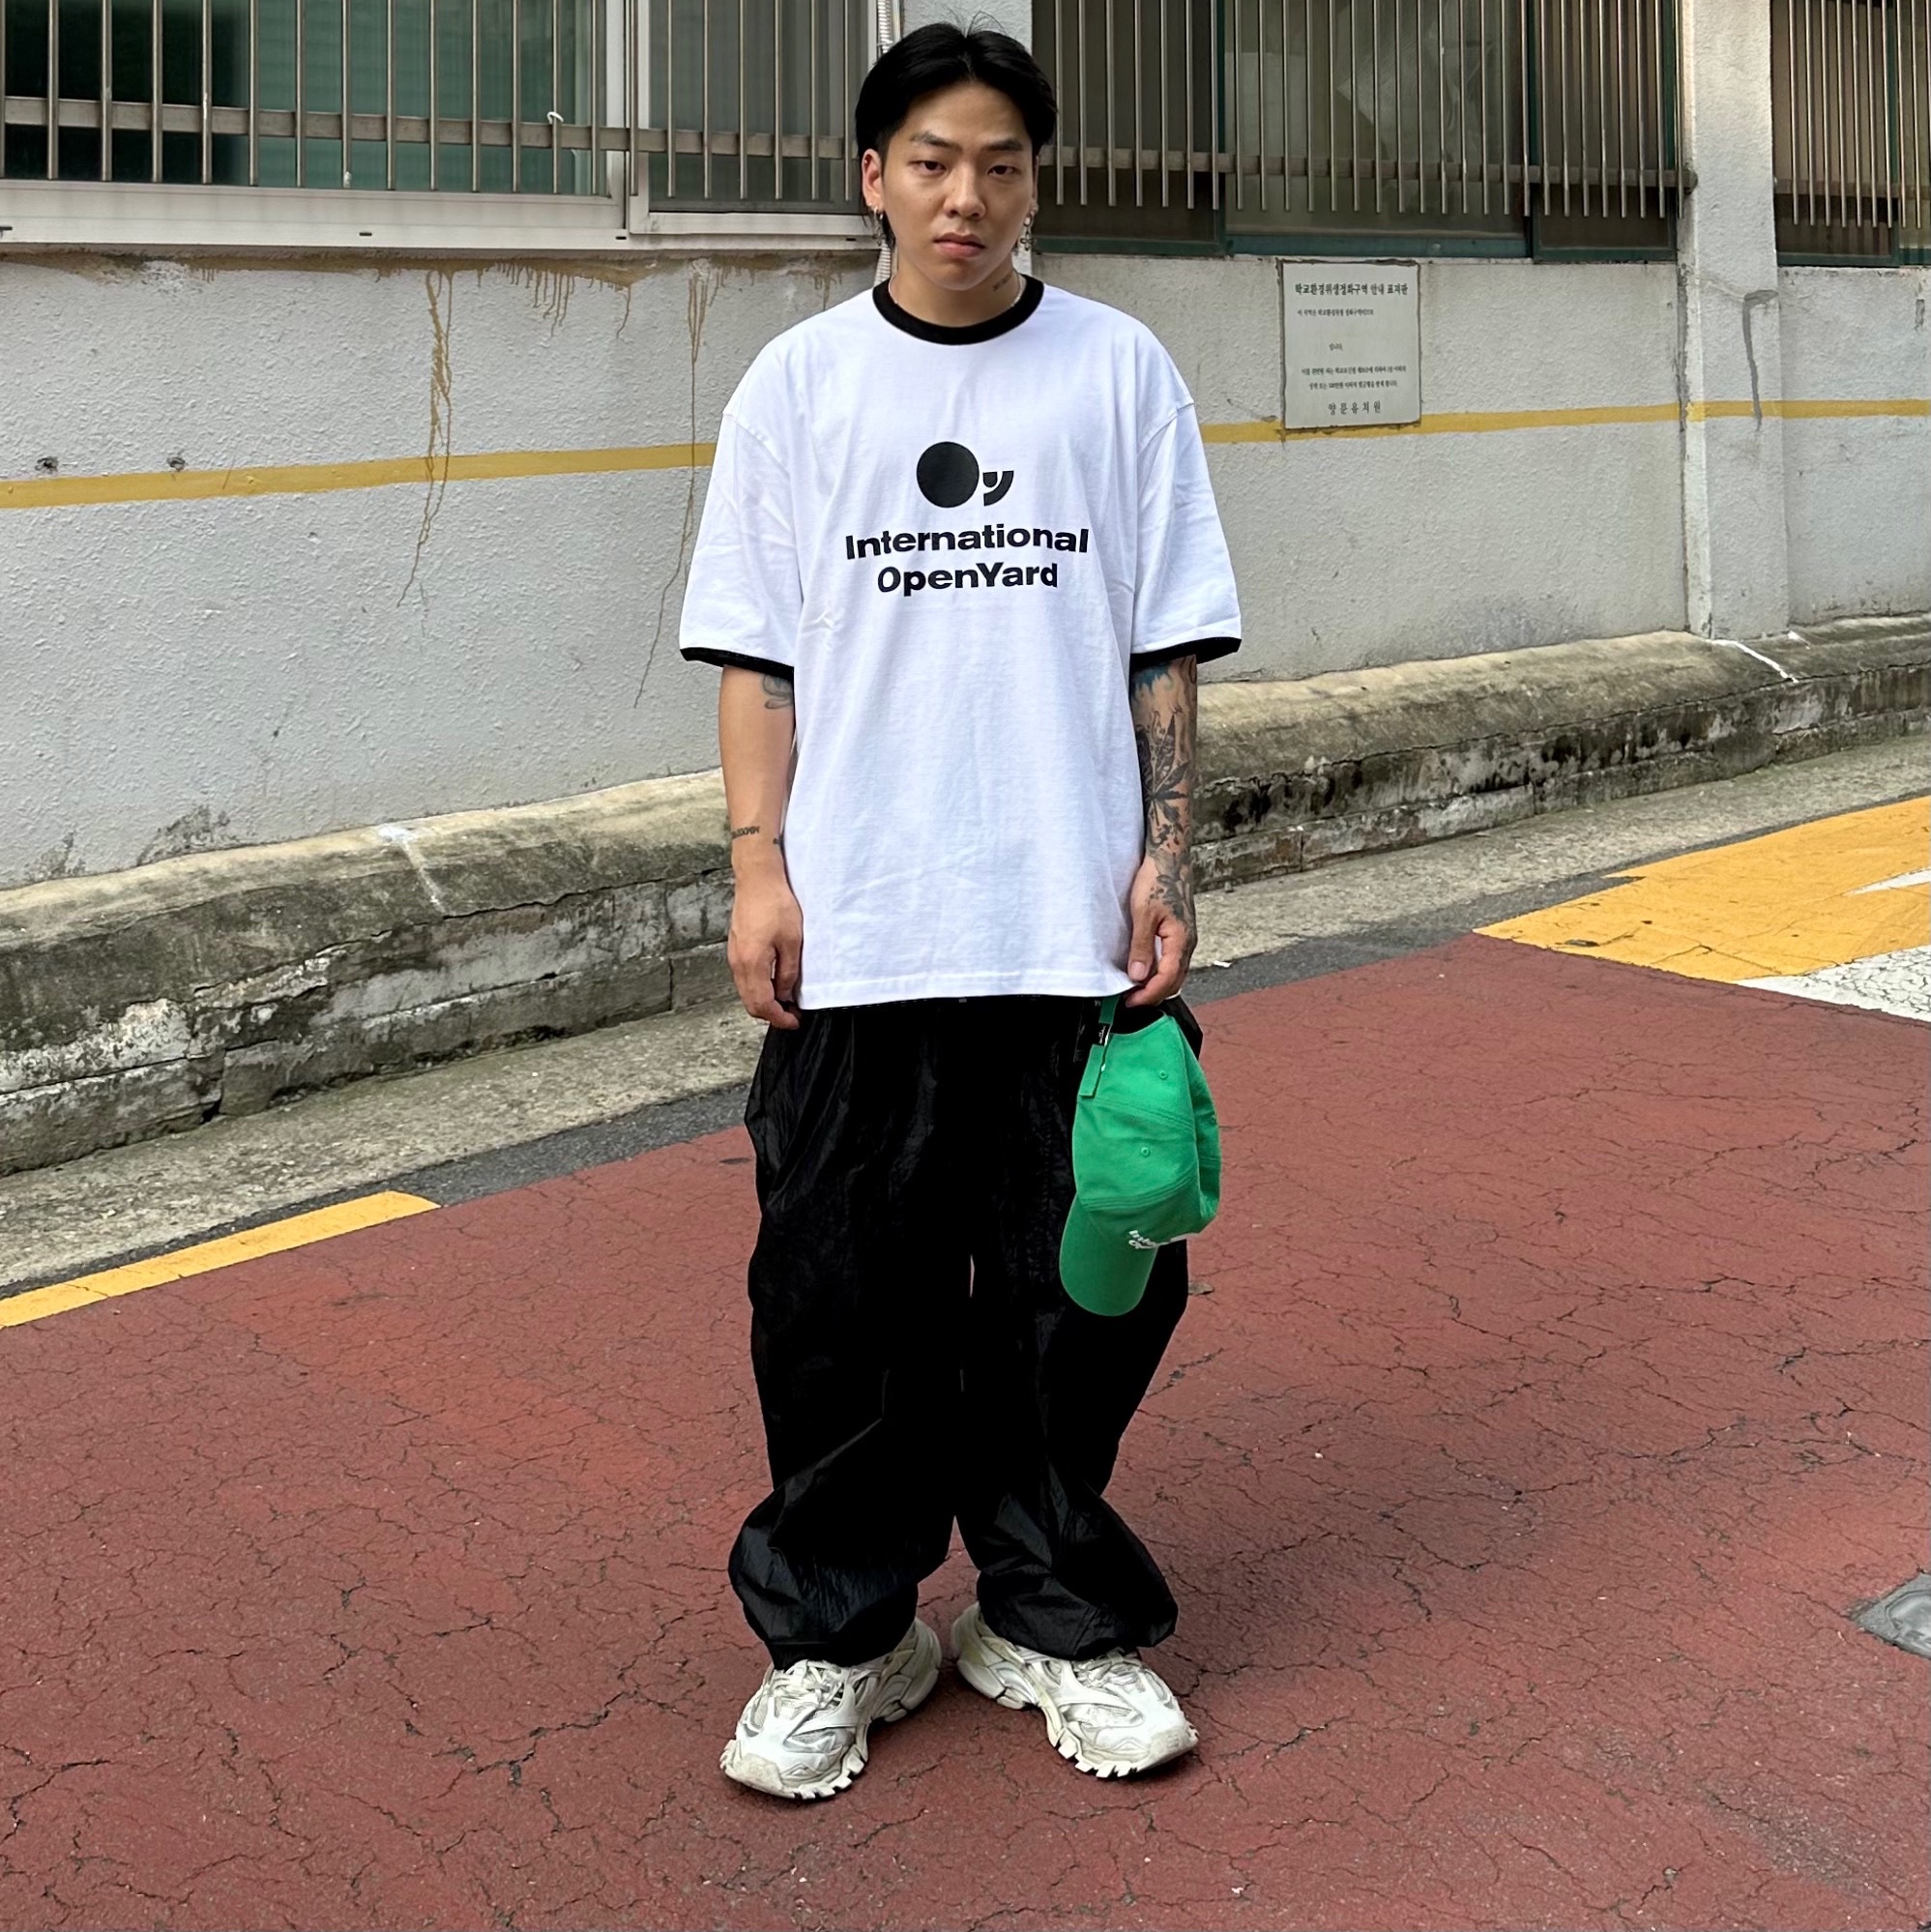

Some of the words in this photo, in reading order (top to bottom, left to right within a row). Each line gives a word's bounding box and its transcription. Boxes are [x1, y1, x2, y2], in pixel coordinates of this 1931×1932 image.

[1370, 282, 1385, 295] 안내
[1387, 282, 1408, 295] 표지판
[845, 523, 1089, 560] International
[877, 562, 1058, 597] OpenYard
